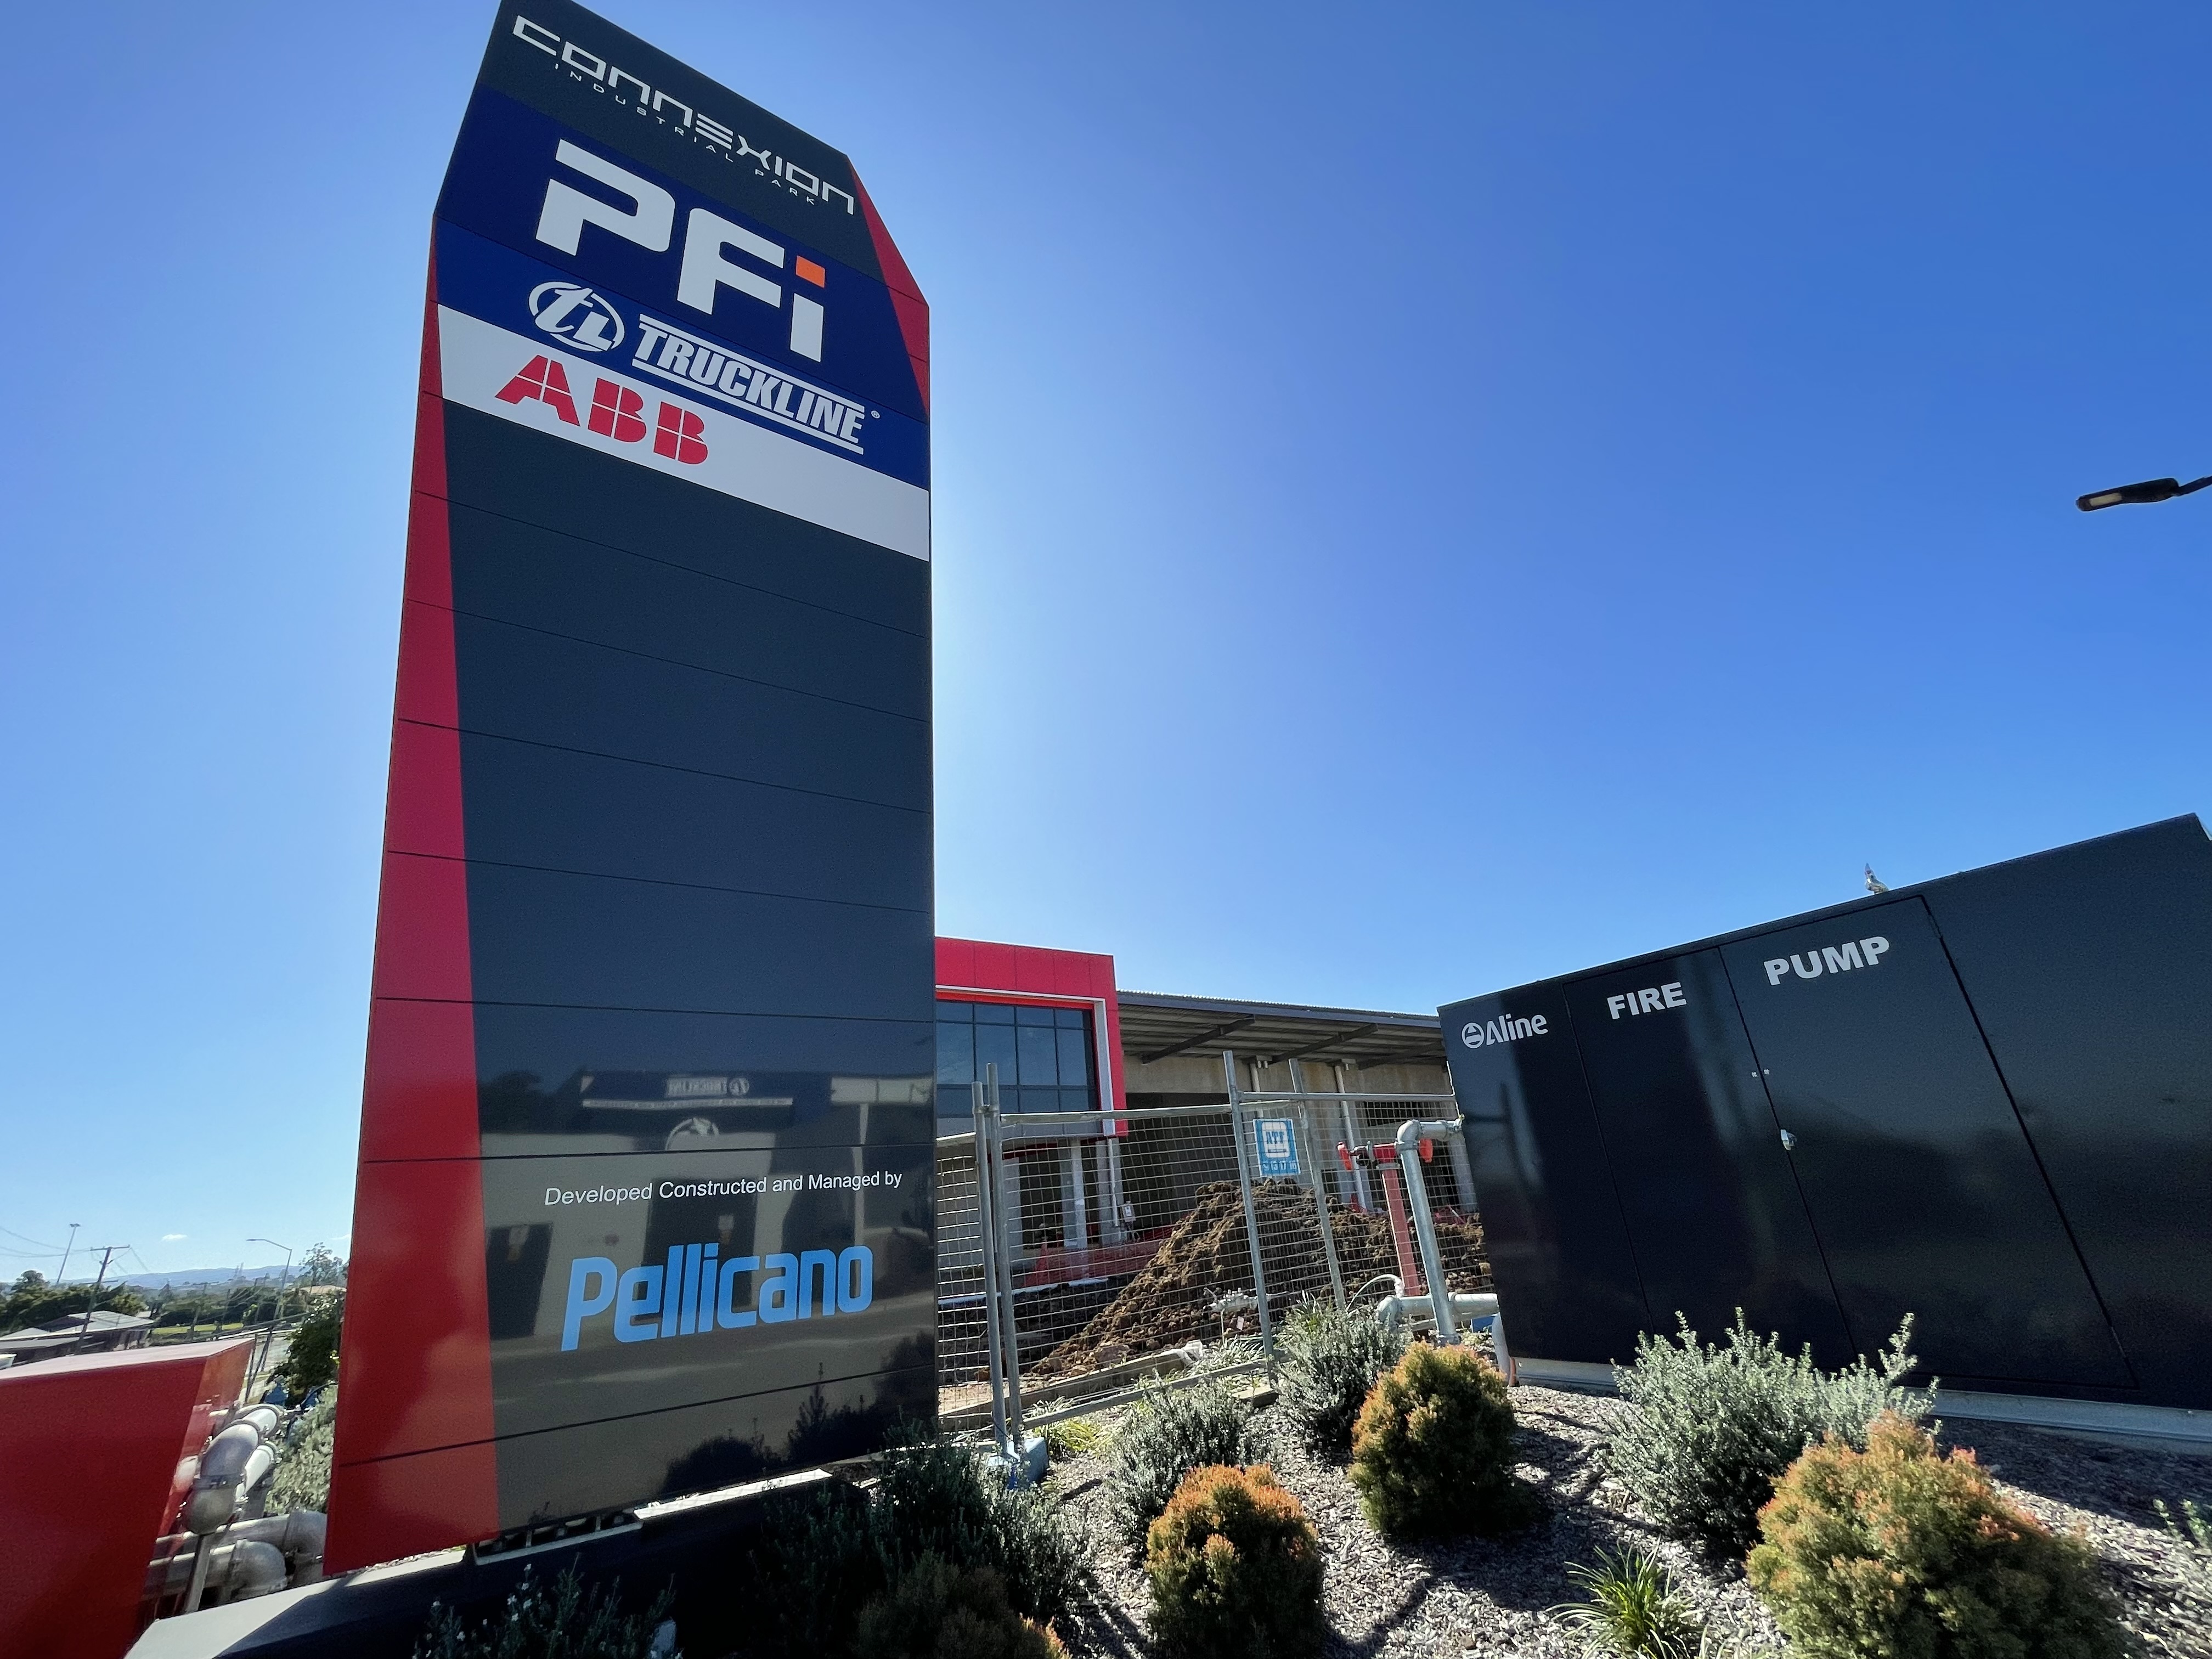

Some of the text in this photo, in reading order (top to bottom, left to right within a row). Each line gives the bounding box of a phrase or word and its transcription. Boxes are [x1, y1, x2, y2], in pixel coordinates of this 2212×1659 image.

[555, 63, 815, 206] INDUSTRIAL PARK
[495, 354, 708, 465] ABB
[634, 323, 865, 443] TRUCKLINE
[1486, 1013, 1548, 1046] Aline
[1607, 936, 1889, 1020] FIRE PUMP
[544, 1171, 902, 1205] Developed Constructed and Managed by
[561, 1243, 873, 1352] Pellicano
